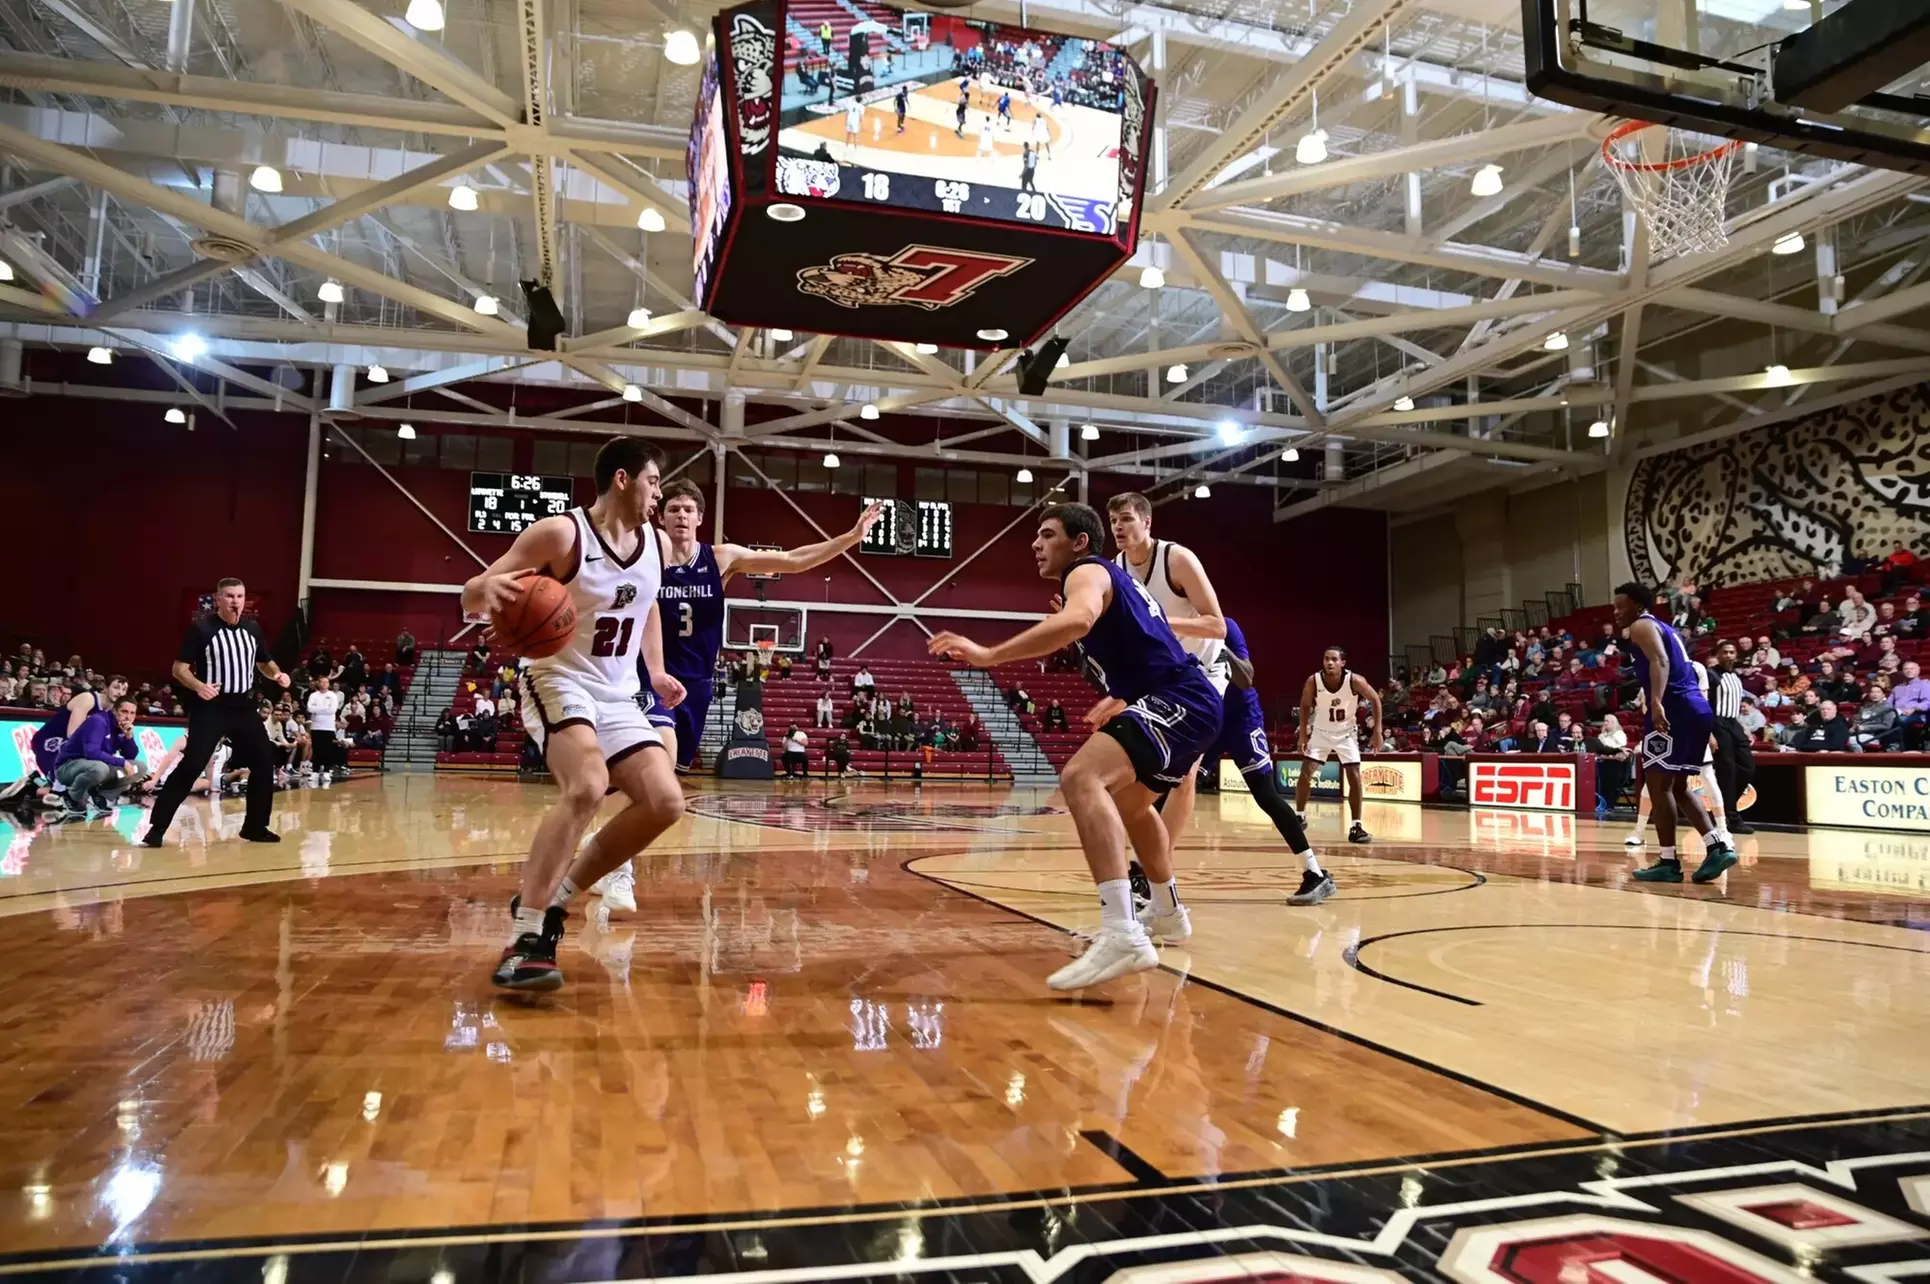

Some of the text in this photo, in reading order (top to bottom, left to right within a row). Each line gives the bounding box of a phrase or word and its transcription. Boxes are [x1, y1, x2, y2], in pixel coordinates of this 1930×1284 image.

[861, 173, 890, 201] 18
[1015, 193, 1047, 220] 20
[511, 475, 541, 491] 6:26
[484, 496, 498, 510] 18
[520, 499, 525, 510] 1
[547, 499, 565, 513] 20
[477, 518, 486, 530] 2
[492, 520, 501, 530] 4
[679, 602, 693, 637] 3
[591, 617, 635, 657] 21
[1328, 708, 1346, 723] 10
[1475, 766, 1572, 806] ESPN
